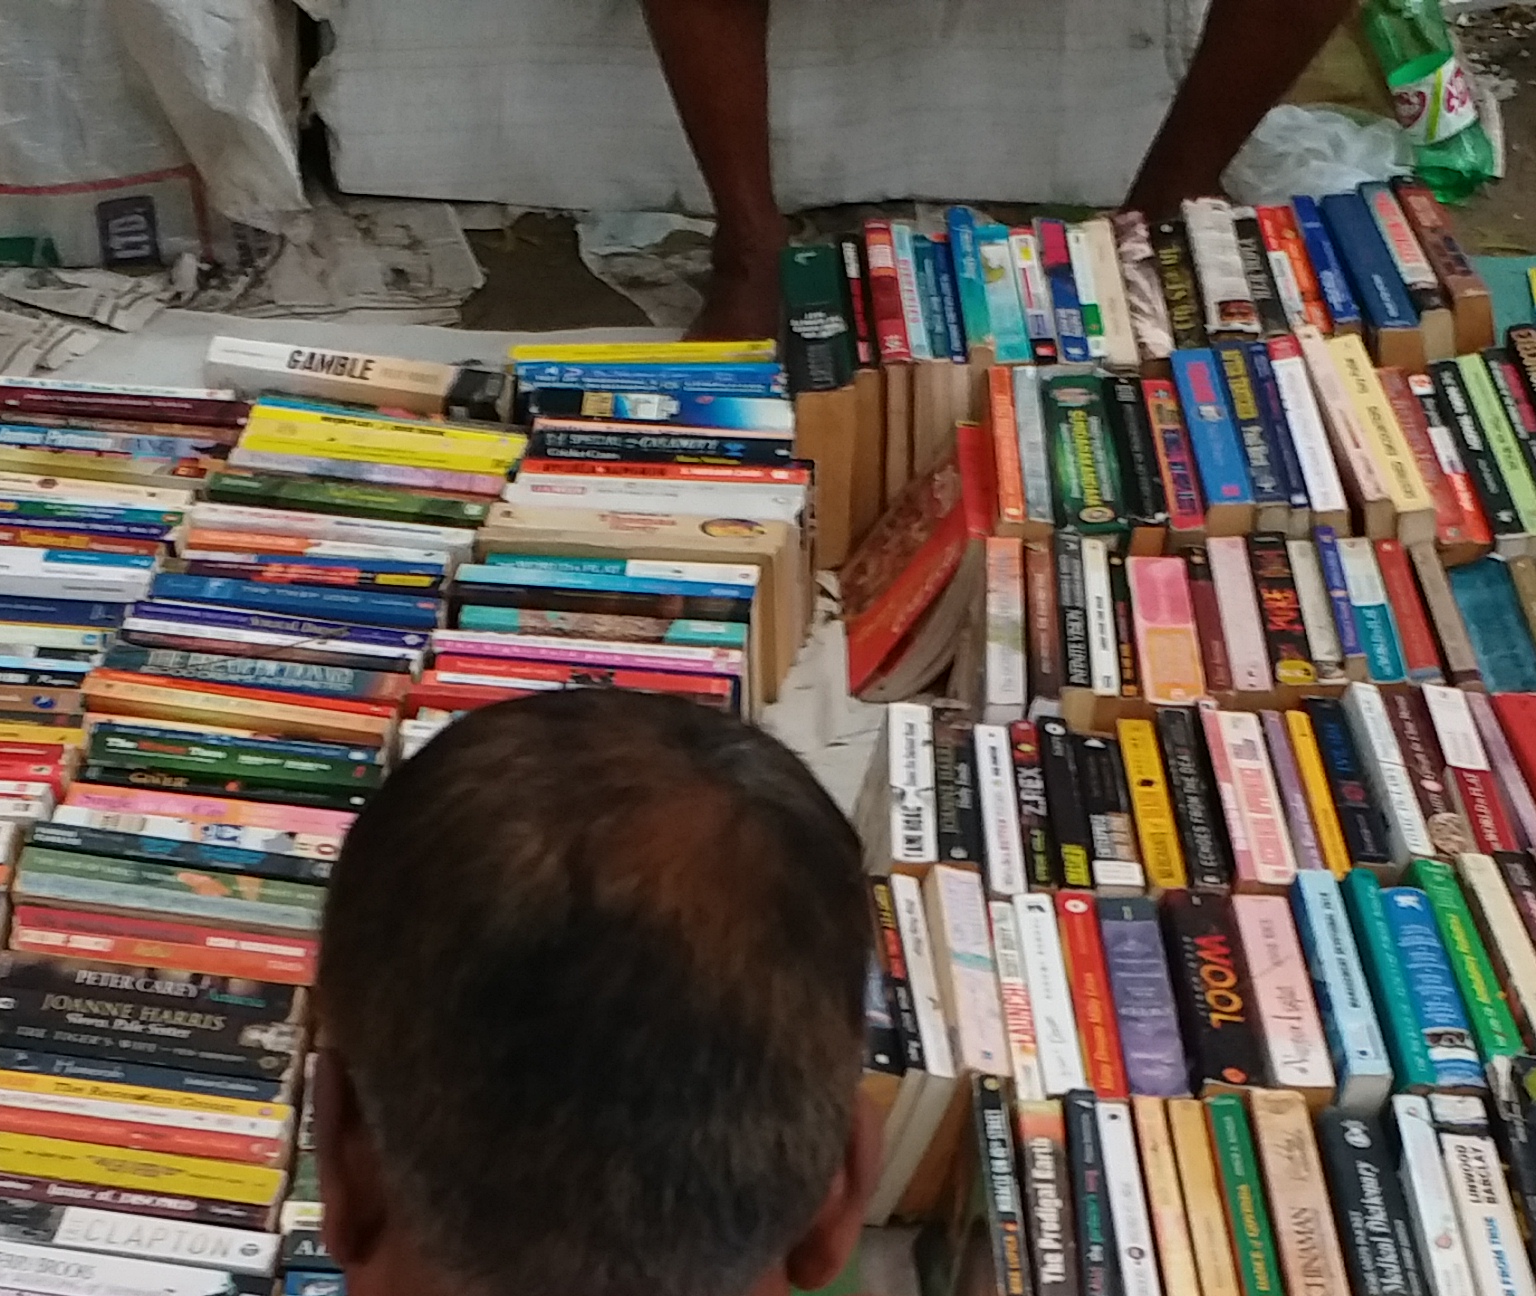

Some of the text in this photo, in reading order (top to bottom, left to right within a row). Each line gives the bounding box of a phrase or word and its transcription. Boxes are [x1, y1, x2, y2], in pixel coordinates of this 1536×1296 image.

[285, 348, 376, 380] GAMBLE
[900, 801, 925, 832] HOAG
[74, 968, 135, 993] PETER
[1193, 934, 1246, 1030] WOOL
[42, 992, 227, 1031] JOANNE HARRIS
[1470, 1146, 1500, 1206] BARCLAY
[1029, 1136, 1066, 1286] The Prodigal Earth
[1361, 1159, 1394, 1235] Dictionary
[79, 1214, 234, 1260] CLAPTON
[1482, 1215, 1507, 1249] TRUE
[1491, 1250, 1517, 1288] FROM
